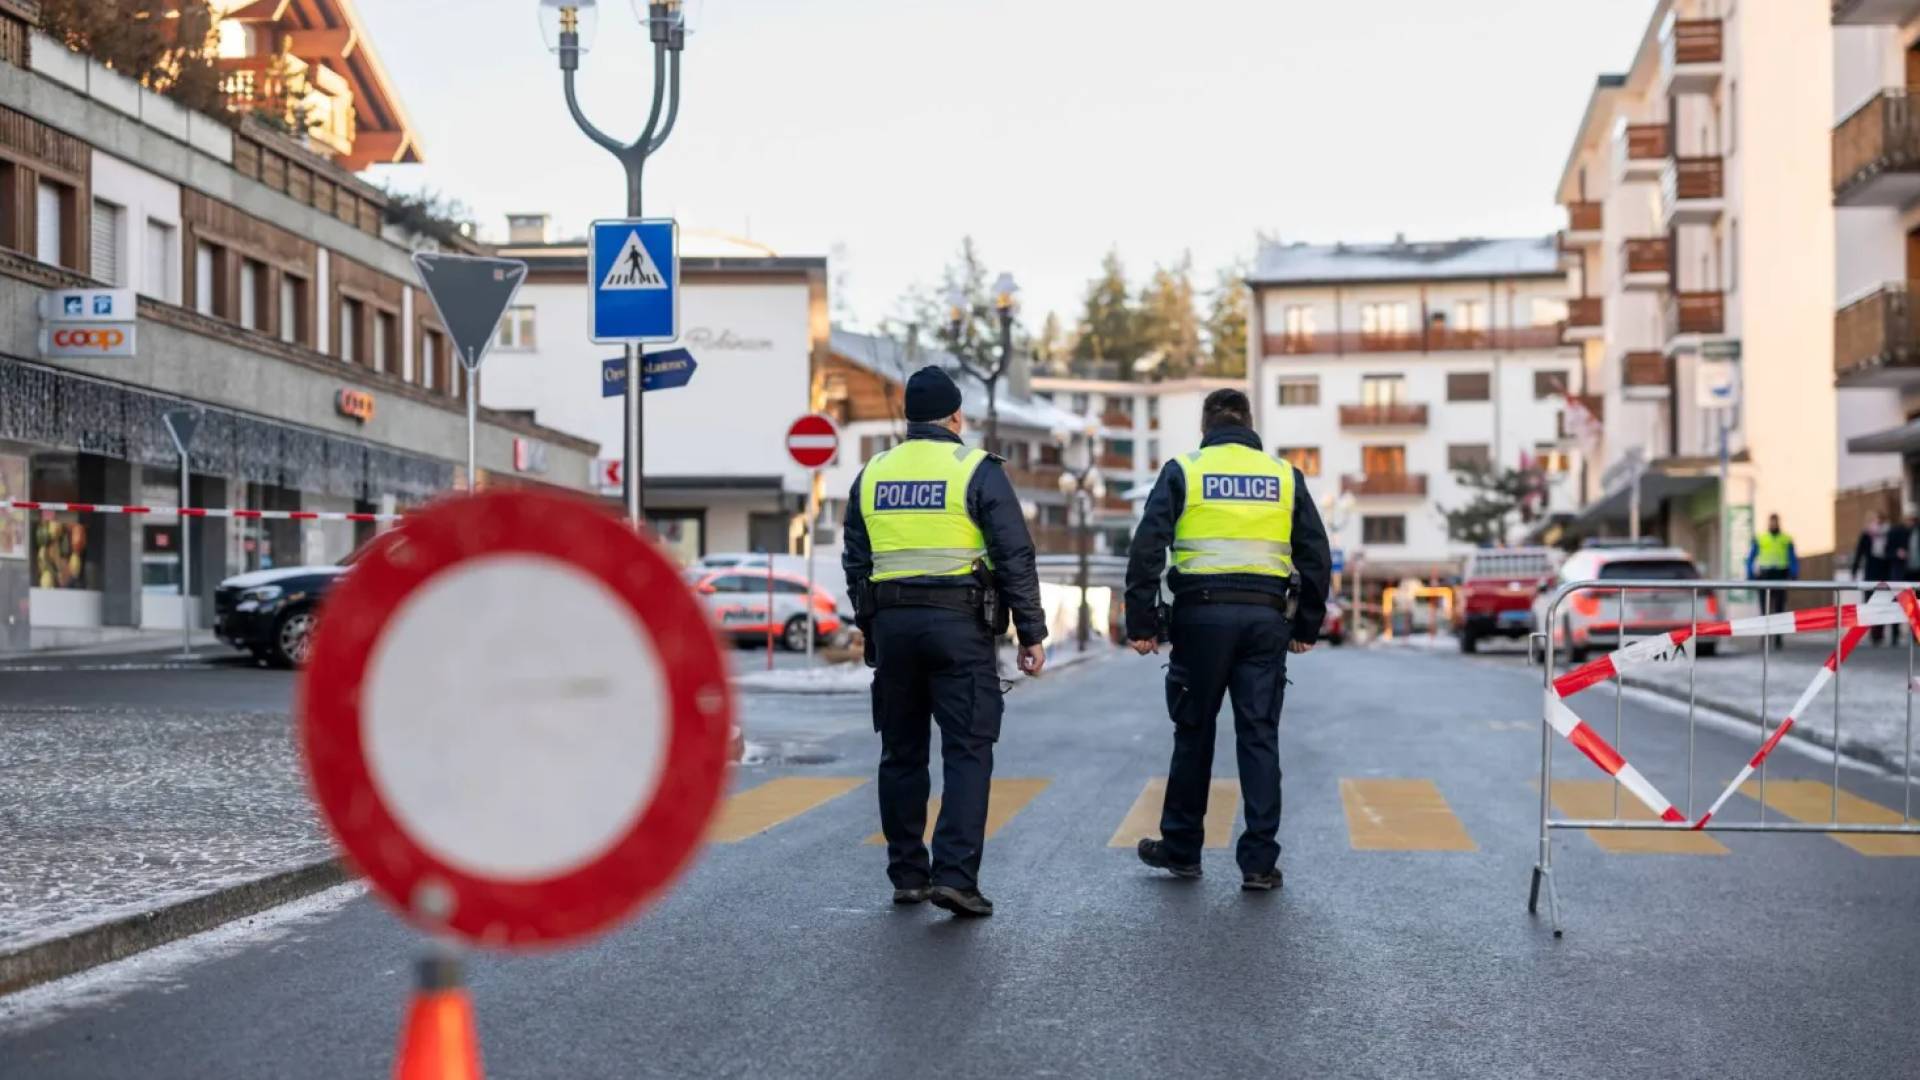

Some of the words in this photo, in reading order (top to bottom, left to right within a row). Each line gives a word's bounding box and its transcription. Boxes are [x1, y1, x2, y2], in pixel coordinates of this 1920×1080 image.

[54, 330, 123, 351] coop
[876, 484, 943, 506] POLICE
[1206, 476, 1277, 499] POLICE
